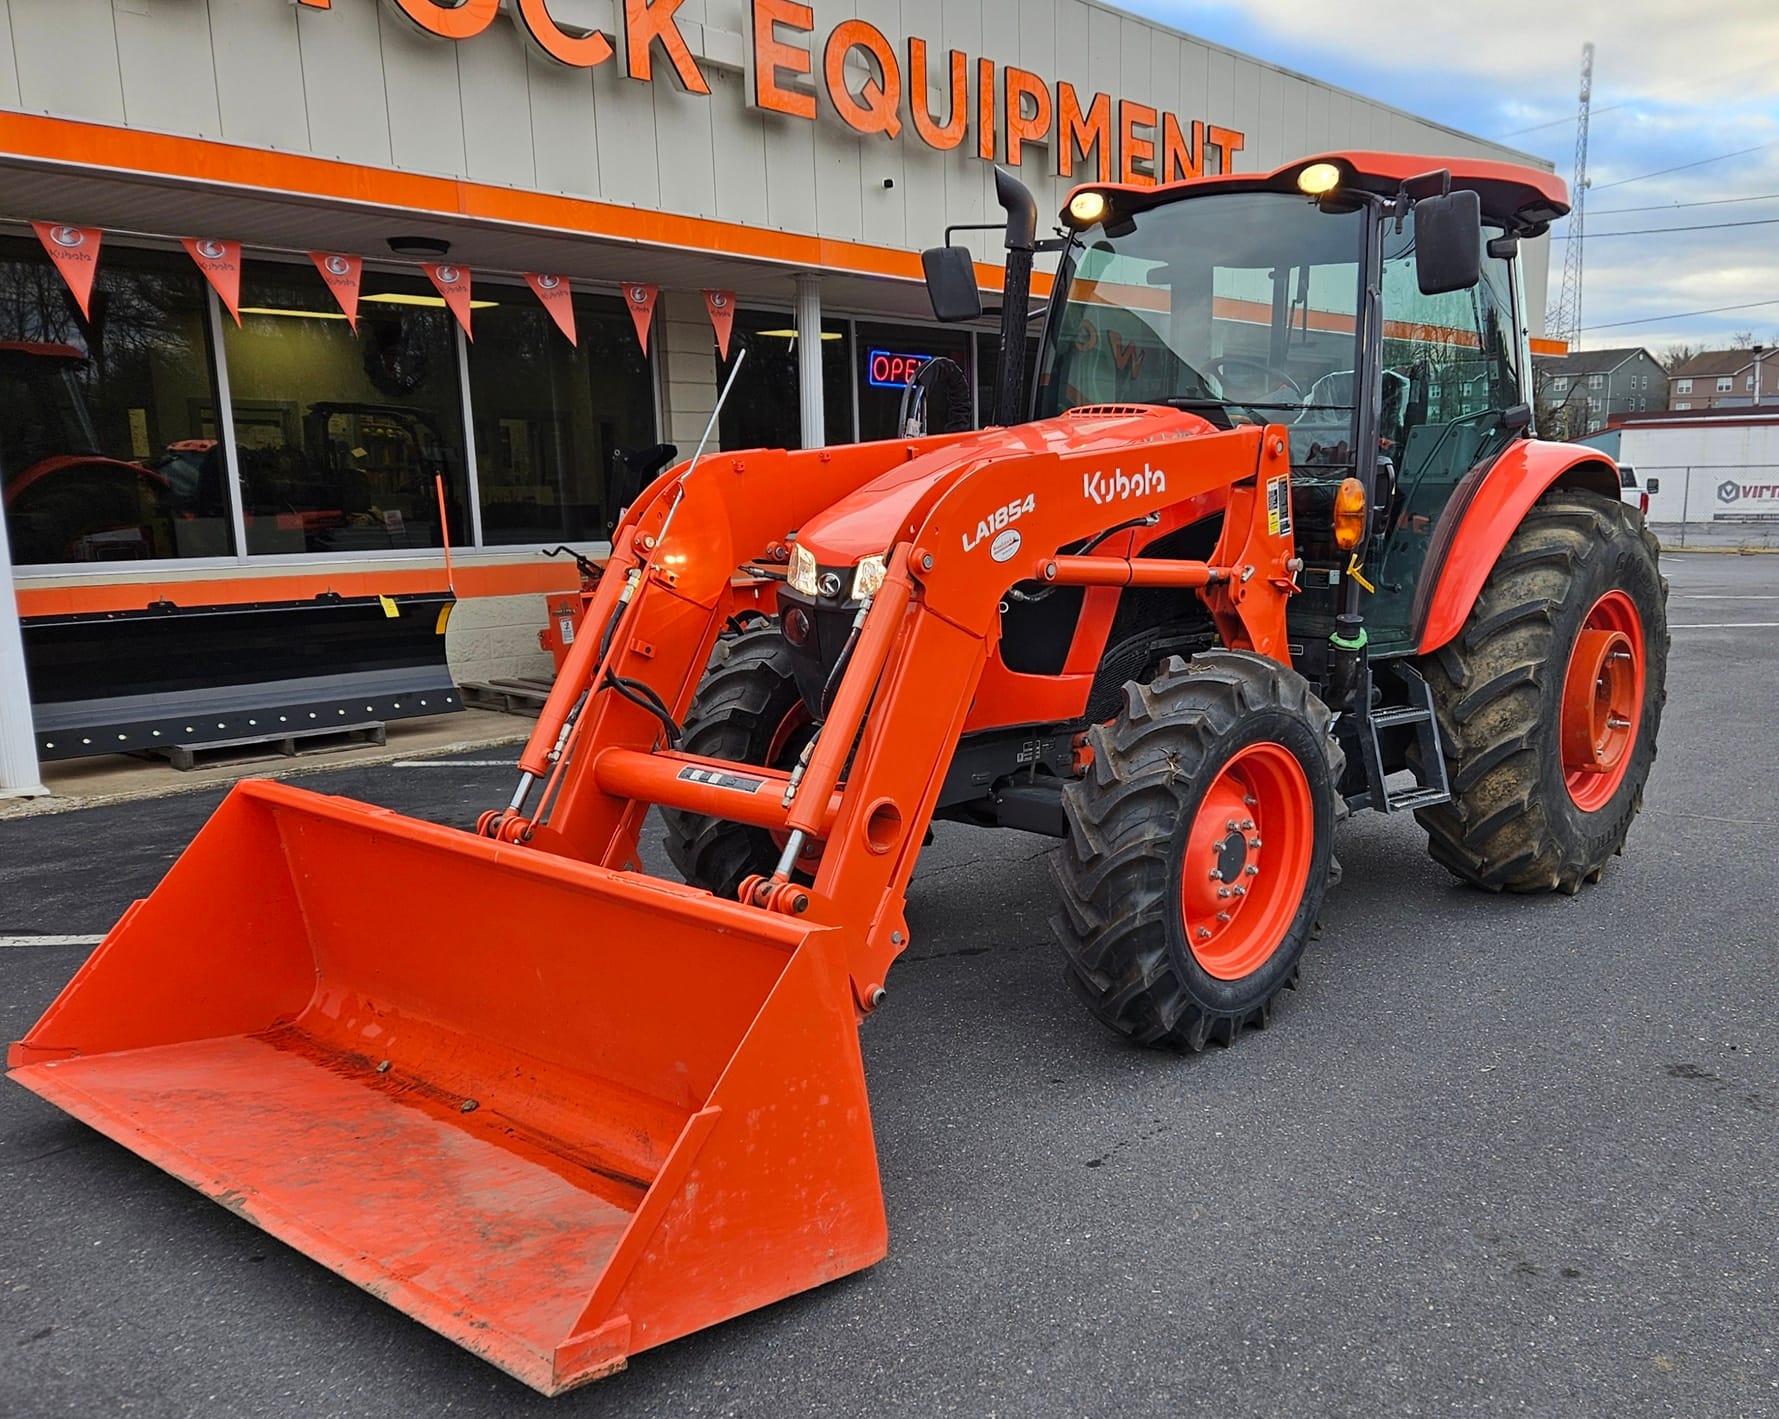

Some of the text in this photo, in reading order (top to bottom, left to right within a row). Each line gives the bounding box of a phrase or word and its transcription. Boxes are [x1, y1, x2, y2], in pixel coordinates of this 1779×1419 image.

[750, 0, 1245, 187] EQUIPMENT
[873, 356, 923, 384] OPE
[1083, 463, 1167, 505] Kubota
[961, 493, 1036, 552] LA1854
